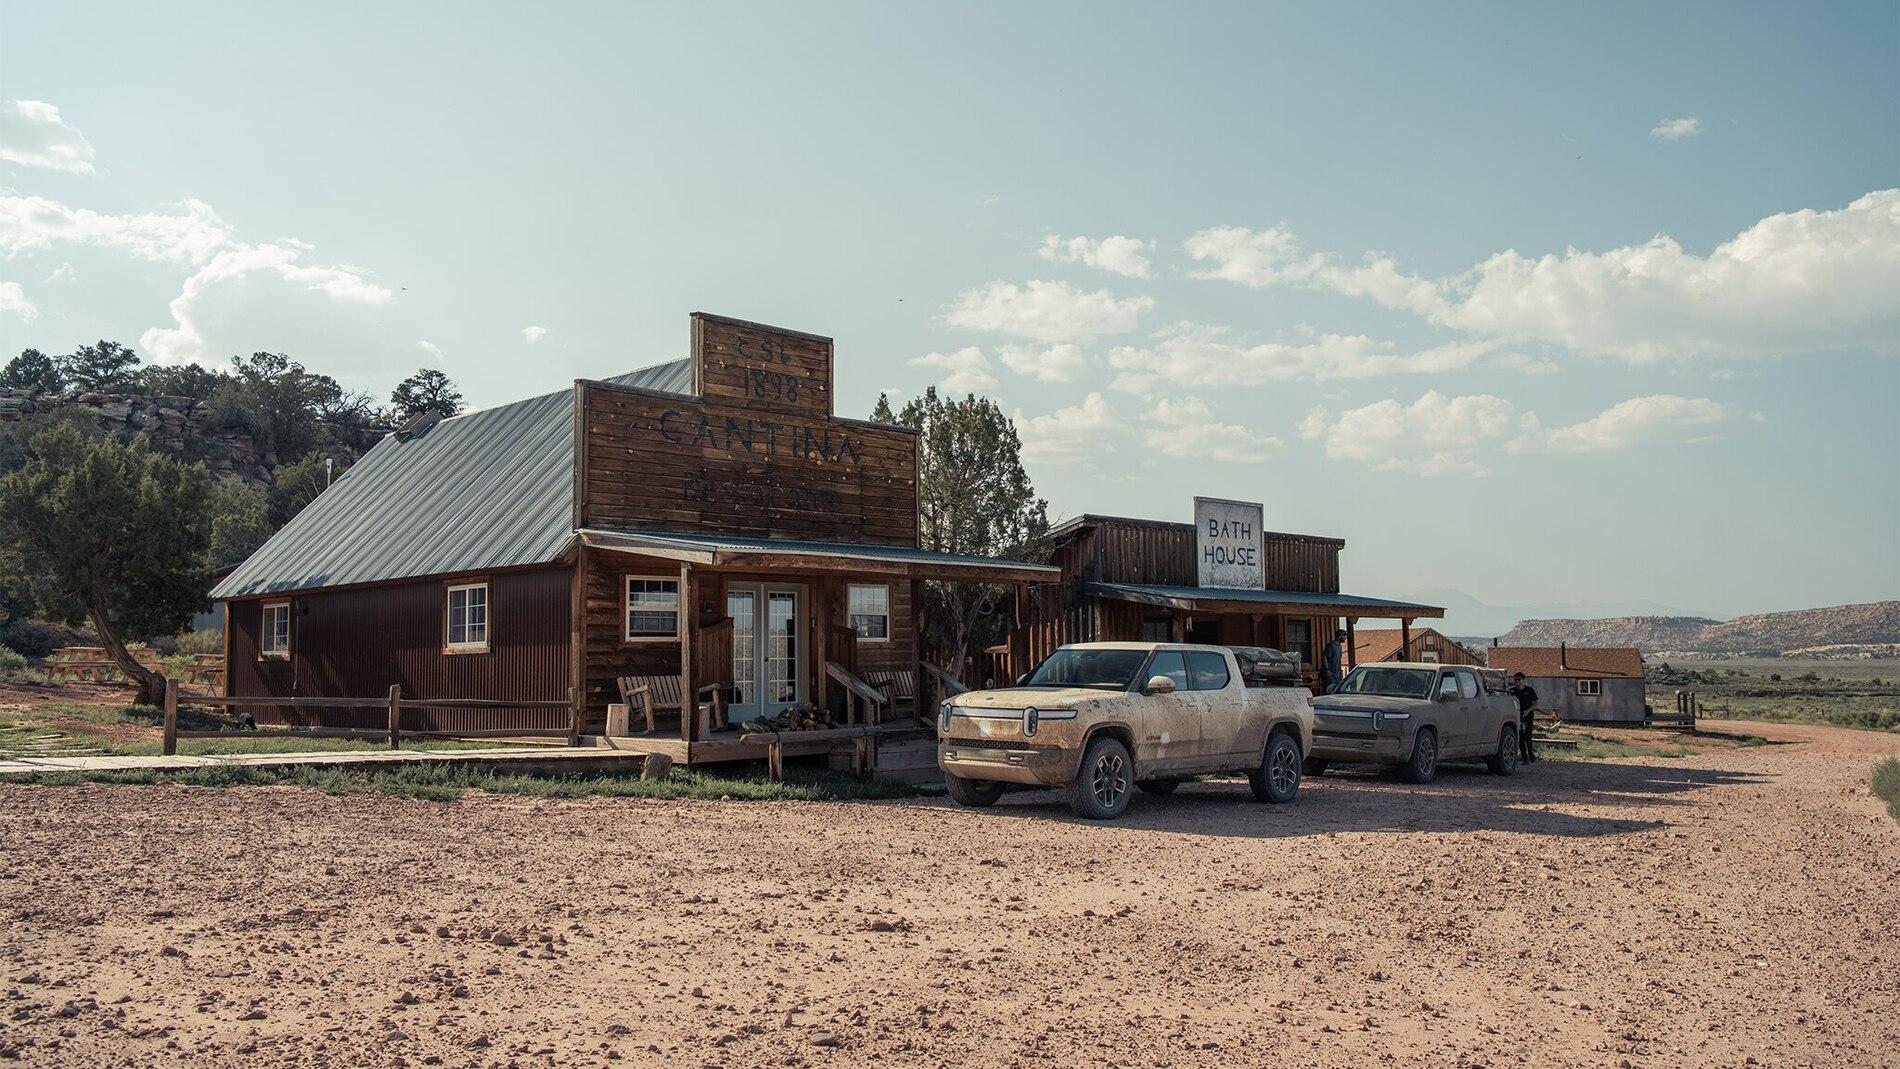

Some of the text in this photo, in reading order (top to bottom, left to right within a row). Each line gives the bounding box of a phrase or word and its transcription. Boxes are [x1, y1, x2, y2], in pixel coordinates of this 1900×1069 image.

[743, 368, 799, 402] 1898
[660, 409, 860, 464] CANTINA
[1208, 518, 1252, 540] BATH
[1203, 545, 1256, 567] HOUSE
